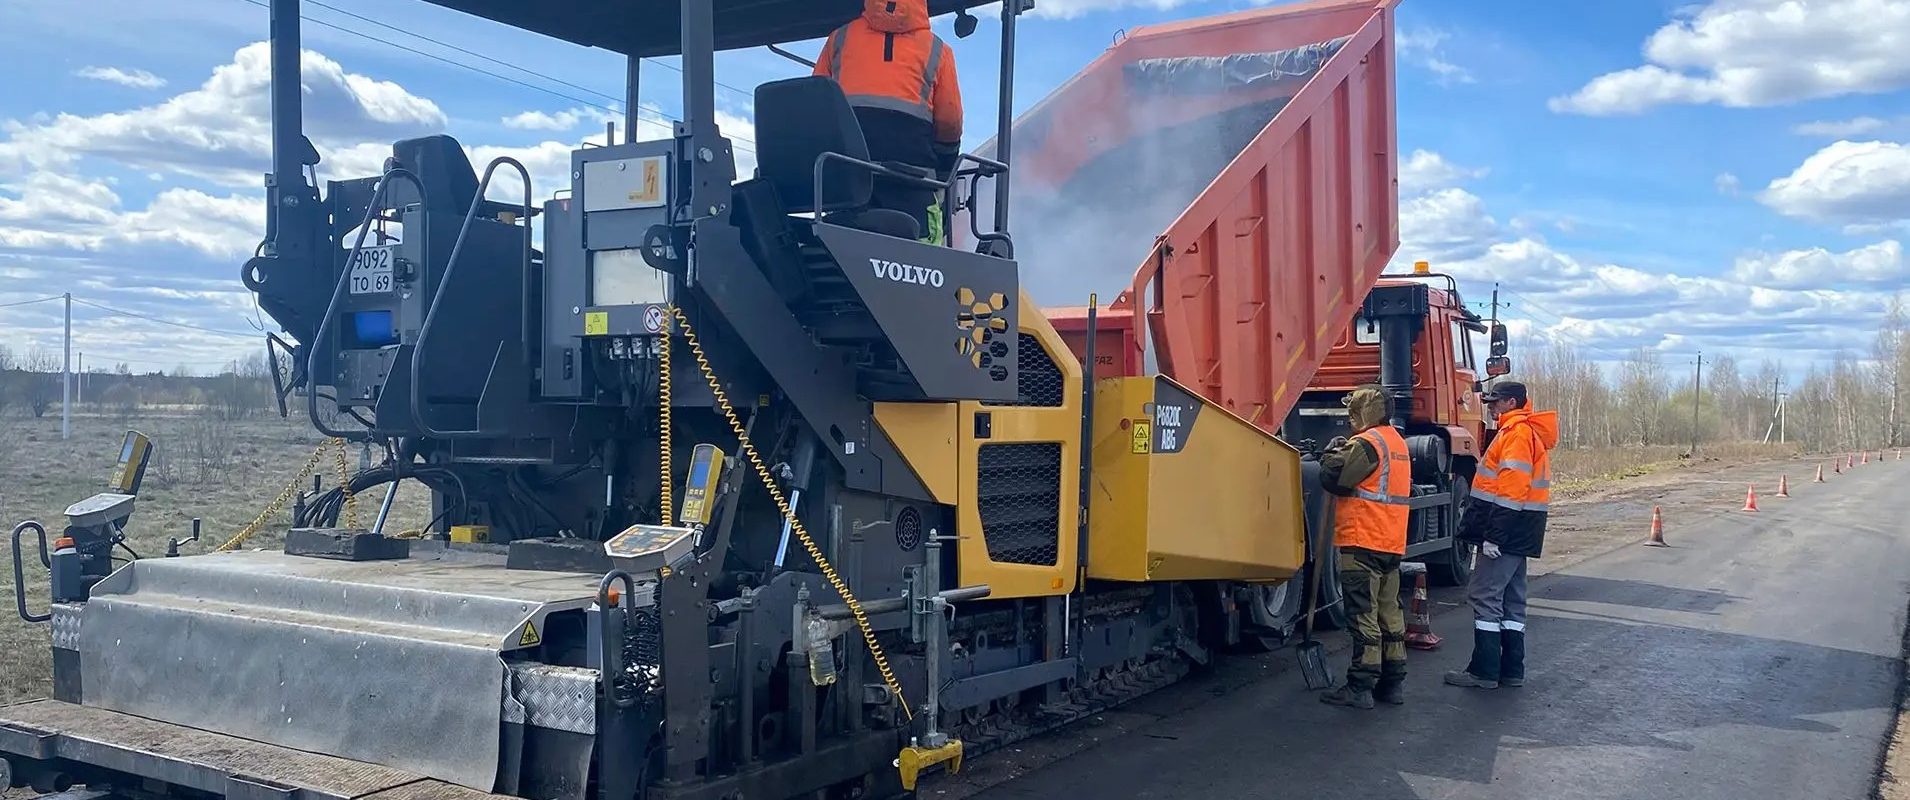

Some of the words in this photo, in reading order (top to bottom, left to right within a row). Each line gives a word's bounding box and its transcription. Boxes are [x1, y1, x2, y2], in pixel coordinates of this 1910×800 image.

[355, 249, 388, 270] 9092
[353, 276, 369, 291] TO
[376, 275, 389, 290] 69
[869, 258, 944, 288] VOLVO
[1156, 404, 1182, 427] P6820C
[1161, 428, 1176, 450] ABG
